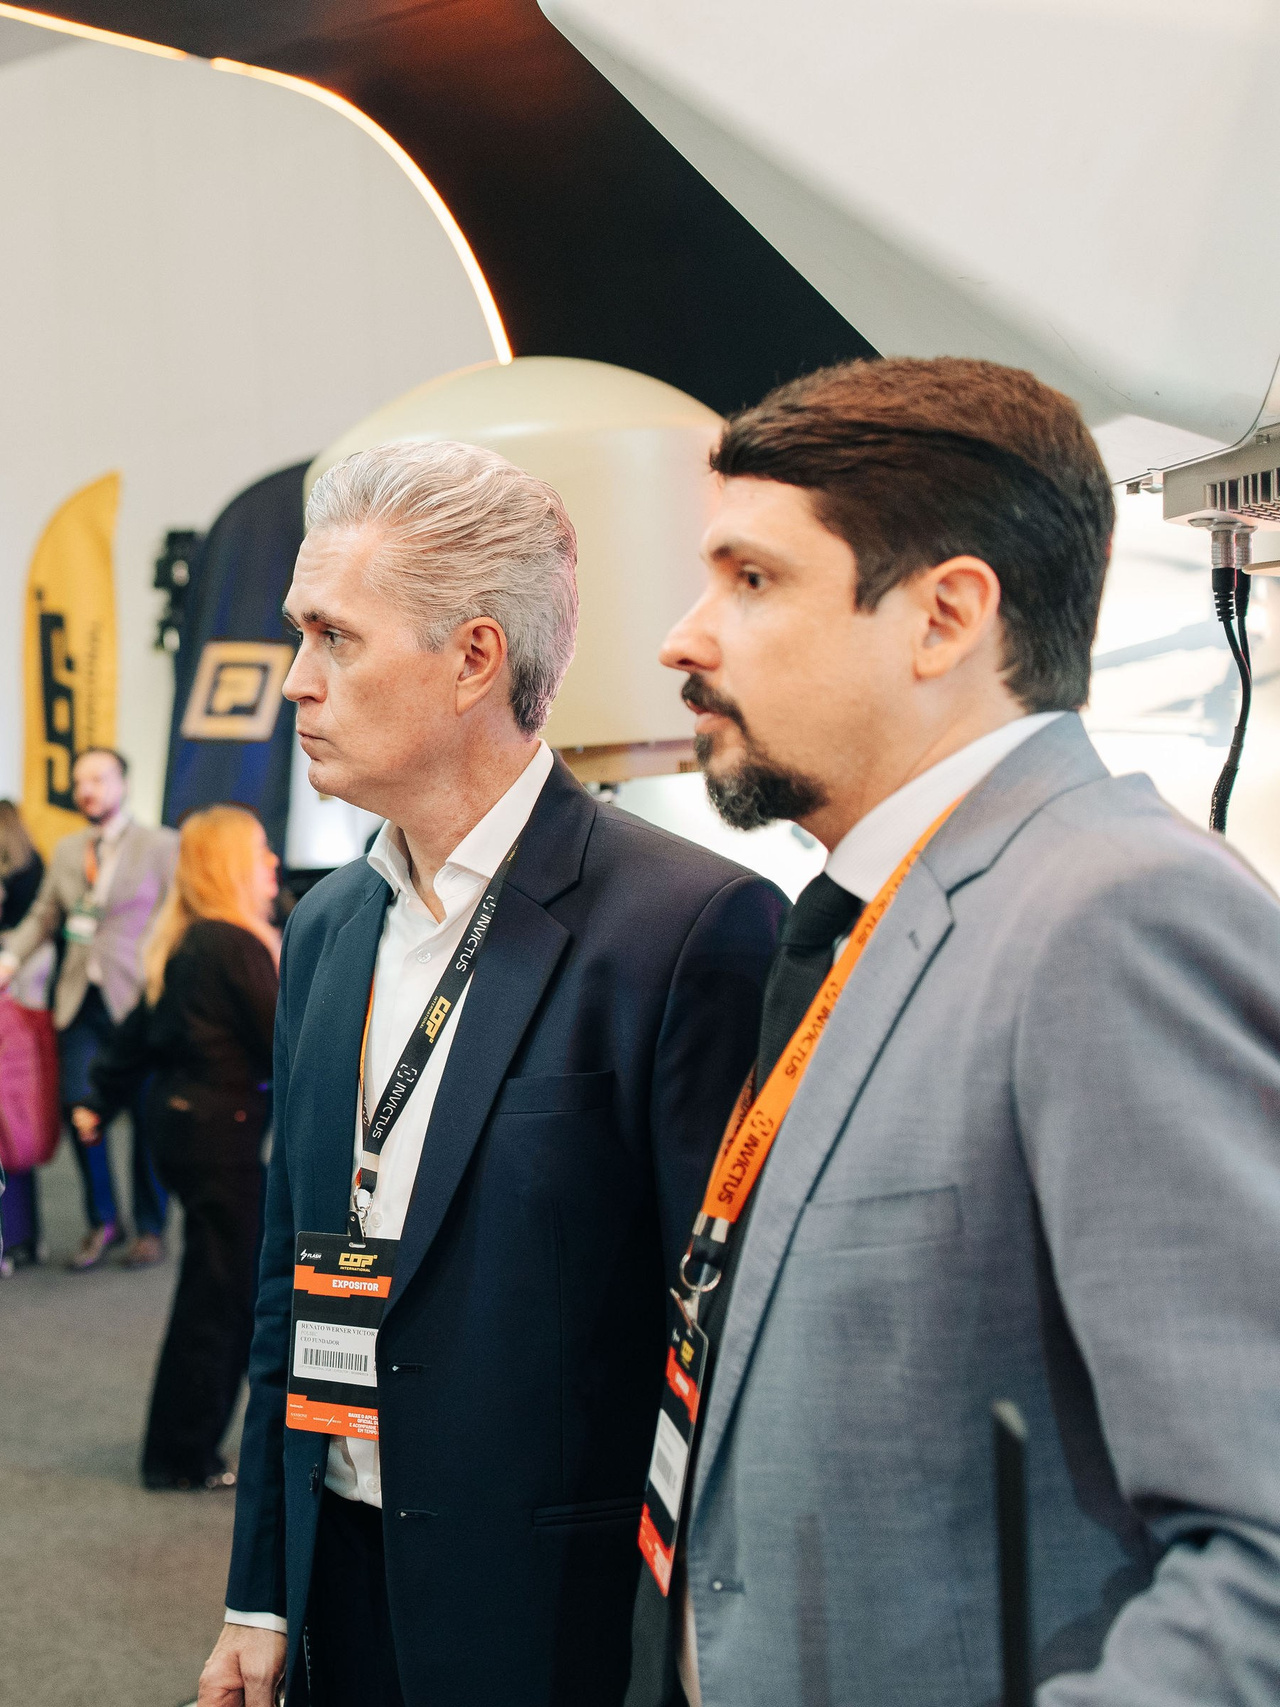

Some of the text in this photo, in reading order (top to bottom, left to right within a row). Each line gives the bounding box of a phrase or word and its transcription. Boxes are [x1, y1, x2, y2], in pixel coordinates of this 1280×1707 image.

[455, 913, 492, 972] INVICTUS
[419, 995, 439, 1029] INTERNATIONAL
[425, 995, 452, 1040] COP
[784, 1005, 831, 1080] INVICTUS
[372, 1081, 407, 1139] INVICTUS
[717, 1133, 760, 1205] INVICTUS
[338, 1252, 374, 1268] COP
[332, 1279, 379, 1292] EXPOSITOR
[301, 1323, 376, 1337] RENATO WERNER VICTOR
